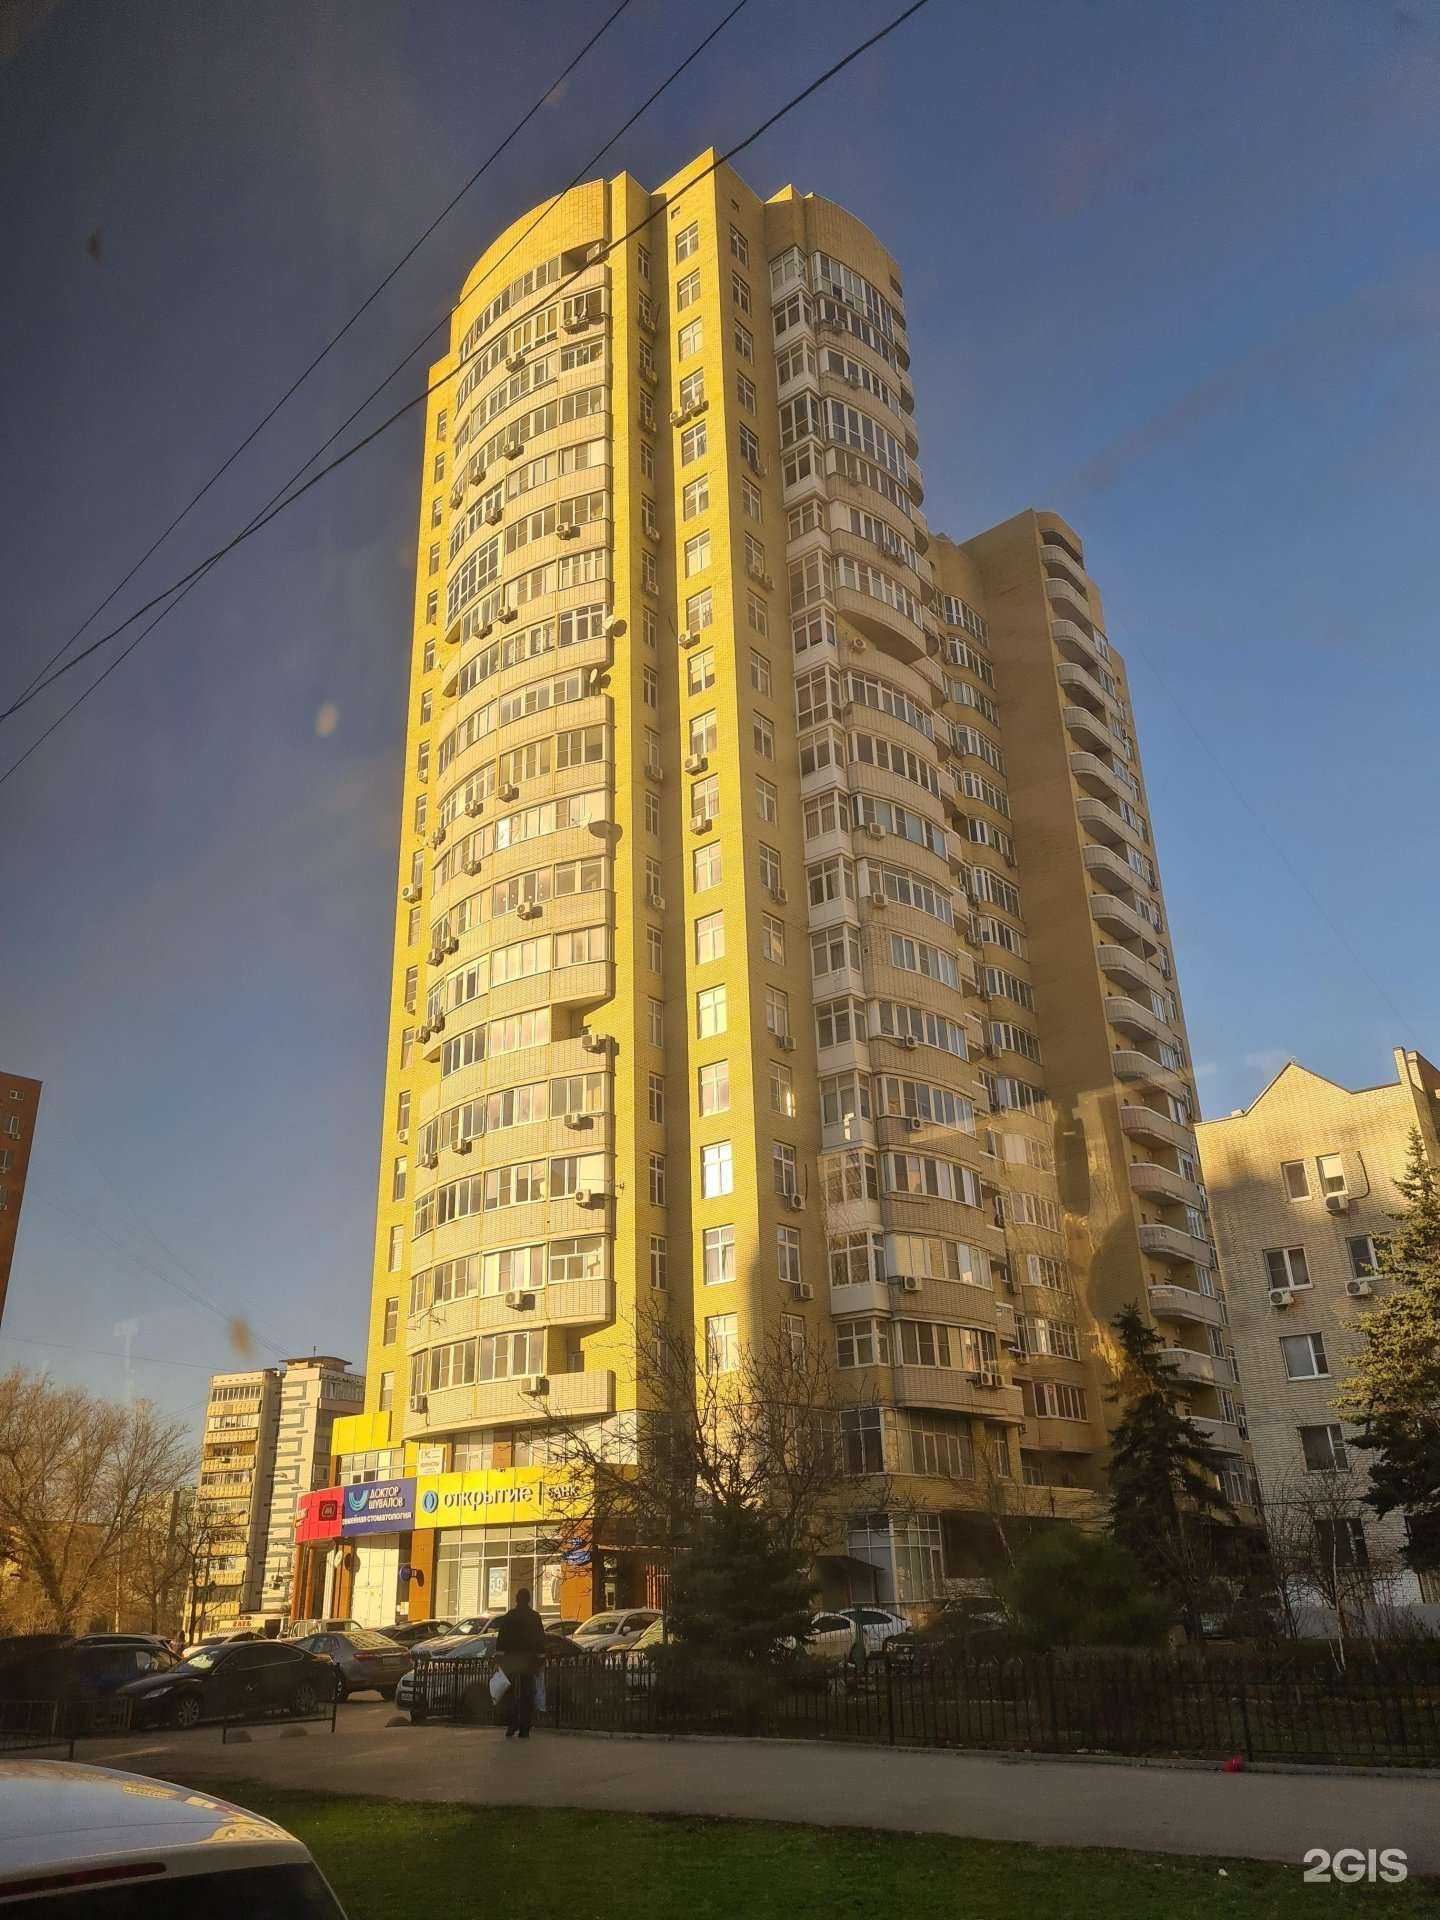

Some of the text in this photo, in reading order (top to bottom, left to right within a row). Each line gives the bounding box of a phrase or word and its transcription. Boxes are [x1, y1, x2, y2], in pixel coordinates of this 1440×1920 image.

[369, 1486, 399, 1499] ДОКТОР
[444, 1486, 533, 1511] открытие
[368, 1497, 403, 1510] ШУВАЛОВ
[367, 1511, 412, 1523] СТОМАТОЛОГИЯ
